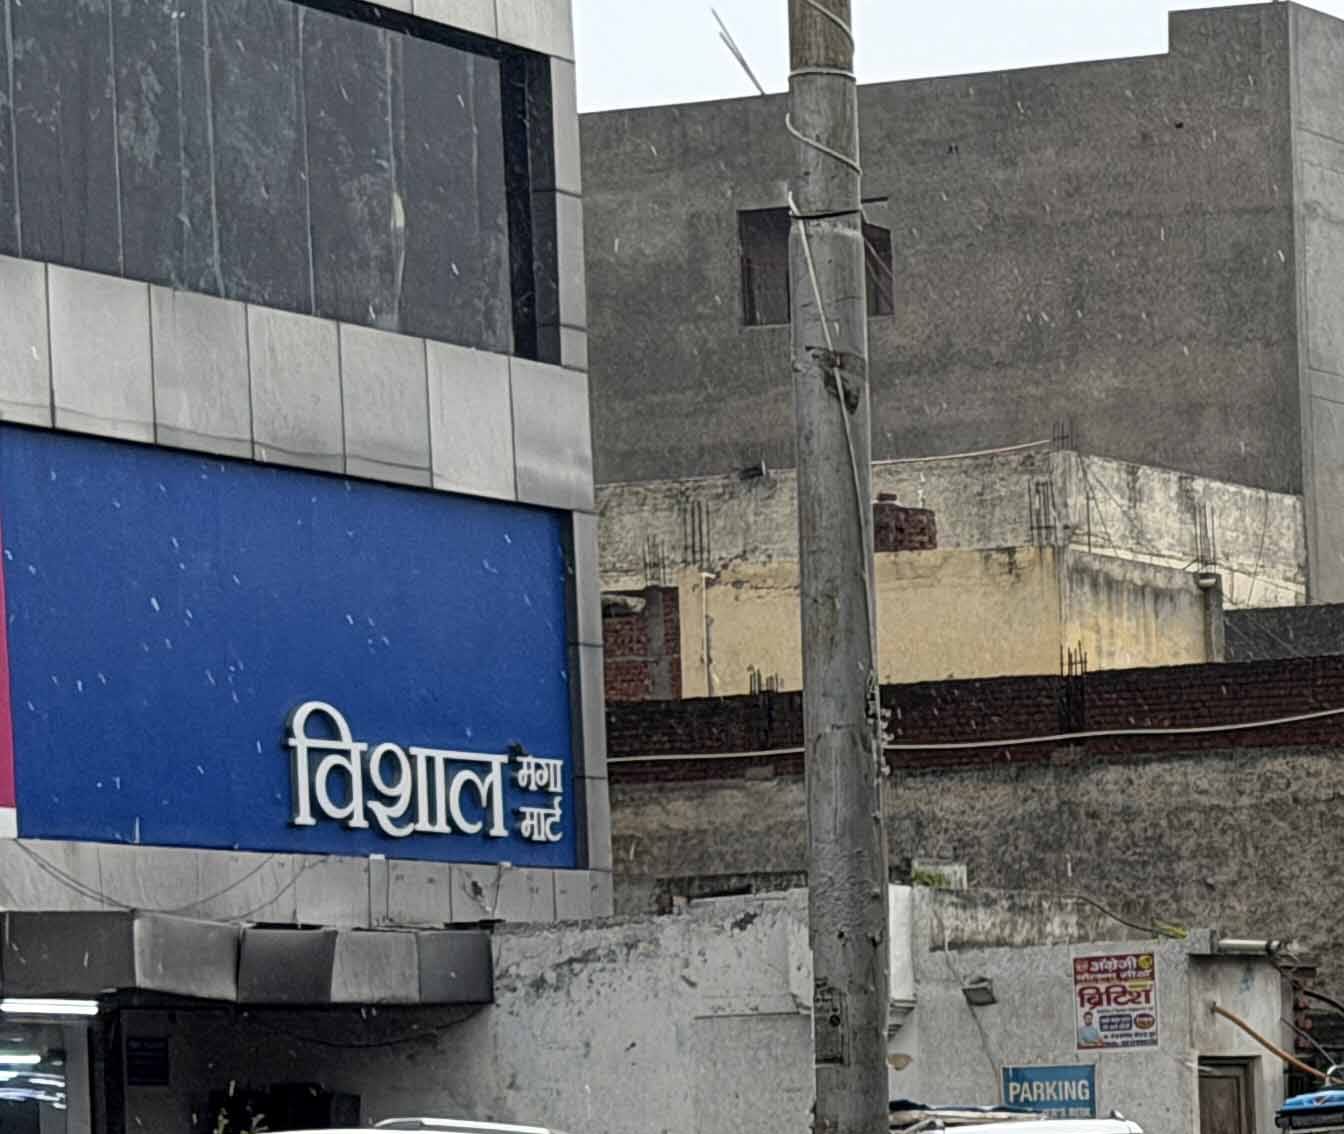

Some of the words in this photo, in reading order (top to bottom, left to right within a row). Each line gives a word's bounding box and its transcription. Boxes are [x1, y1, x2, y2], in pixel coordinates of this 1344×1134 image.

[288, 700, 508, 838] विशाल
[519, 796, 564, 842] मार्ट
[1008, 1079, 1090, 1104] PARKING
